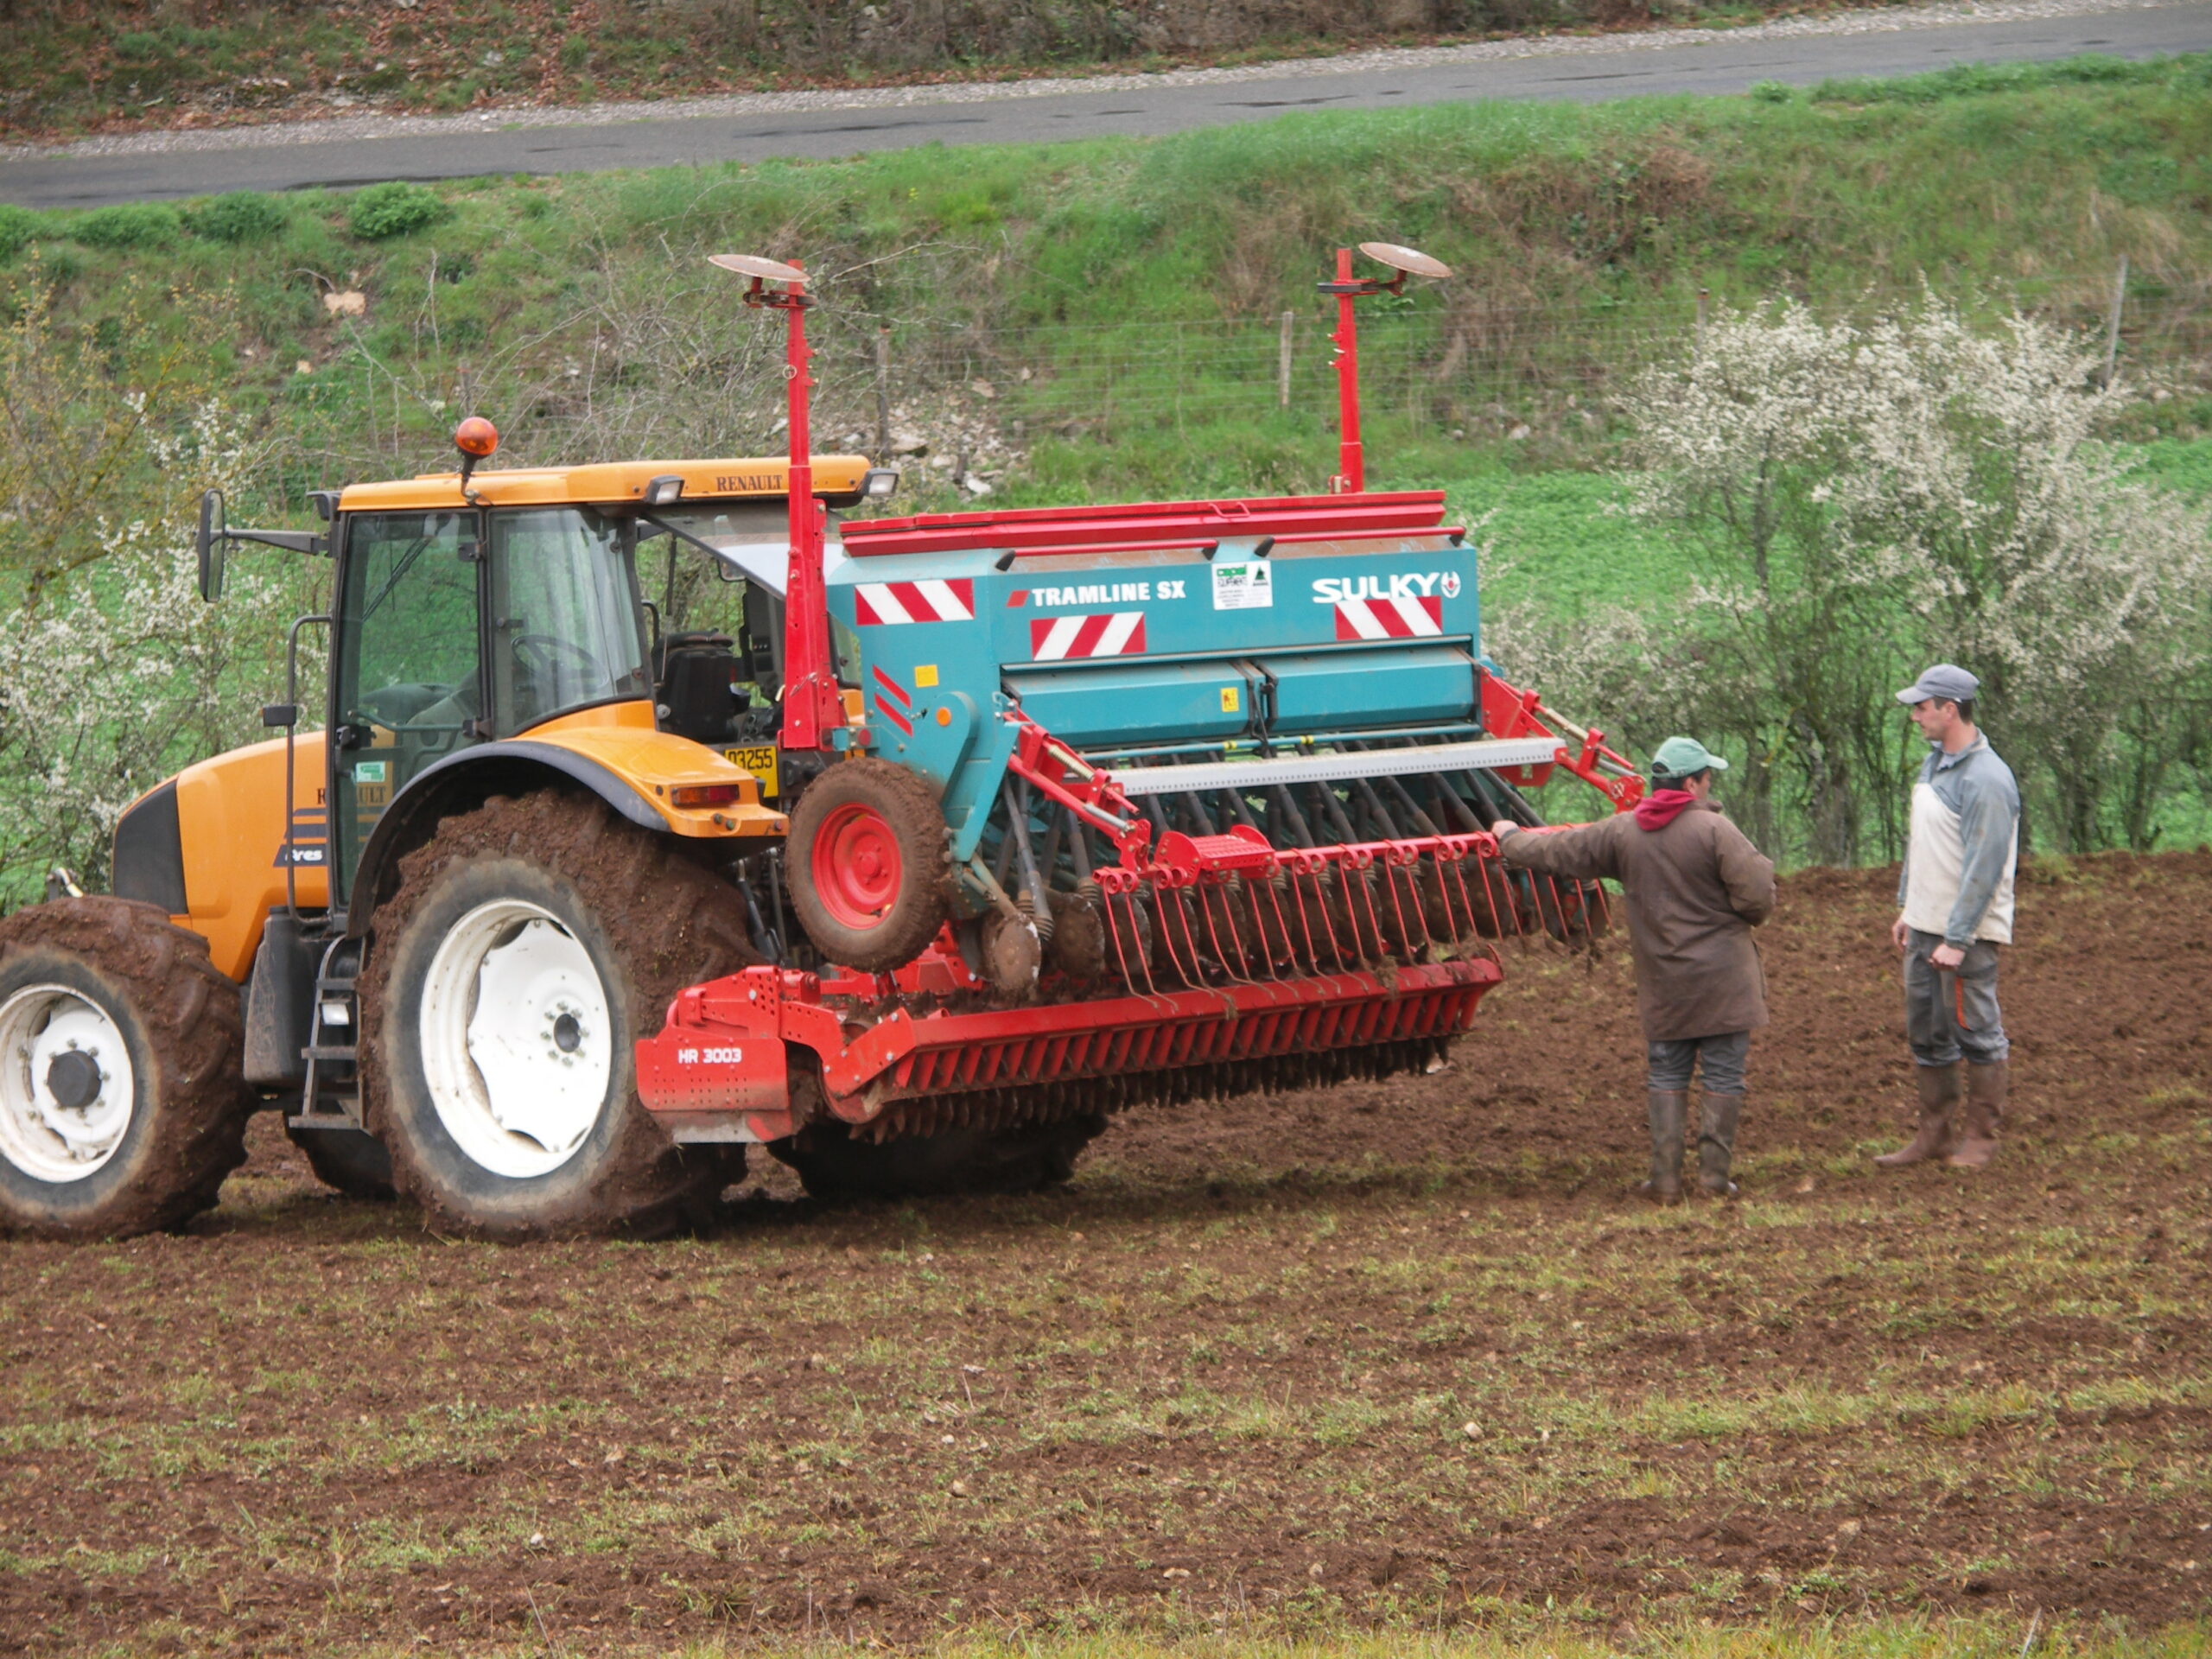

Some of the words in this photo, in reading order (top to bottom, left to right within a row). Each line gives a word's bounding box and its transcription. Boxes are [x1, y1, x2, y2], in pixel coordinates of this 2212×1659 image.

[716, 474, 782, 492] RENAULT
[1032, 582, 1151, 607] TRAMLINE
[1157, 580, 1186, 600] SX
[1312, 571, 1440, 604] SULKY
[677, 1048, 699, 1064] HR
[702, 1047, 742, 1064] 3003
